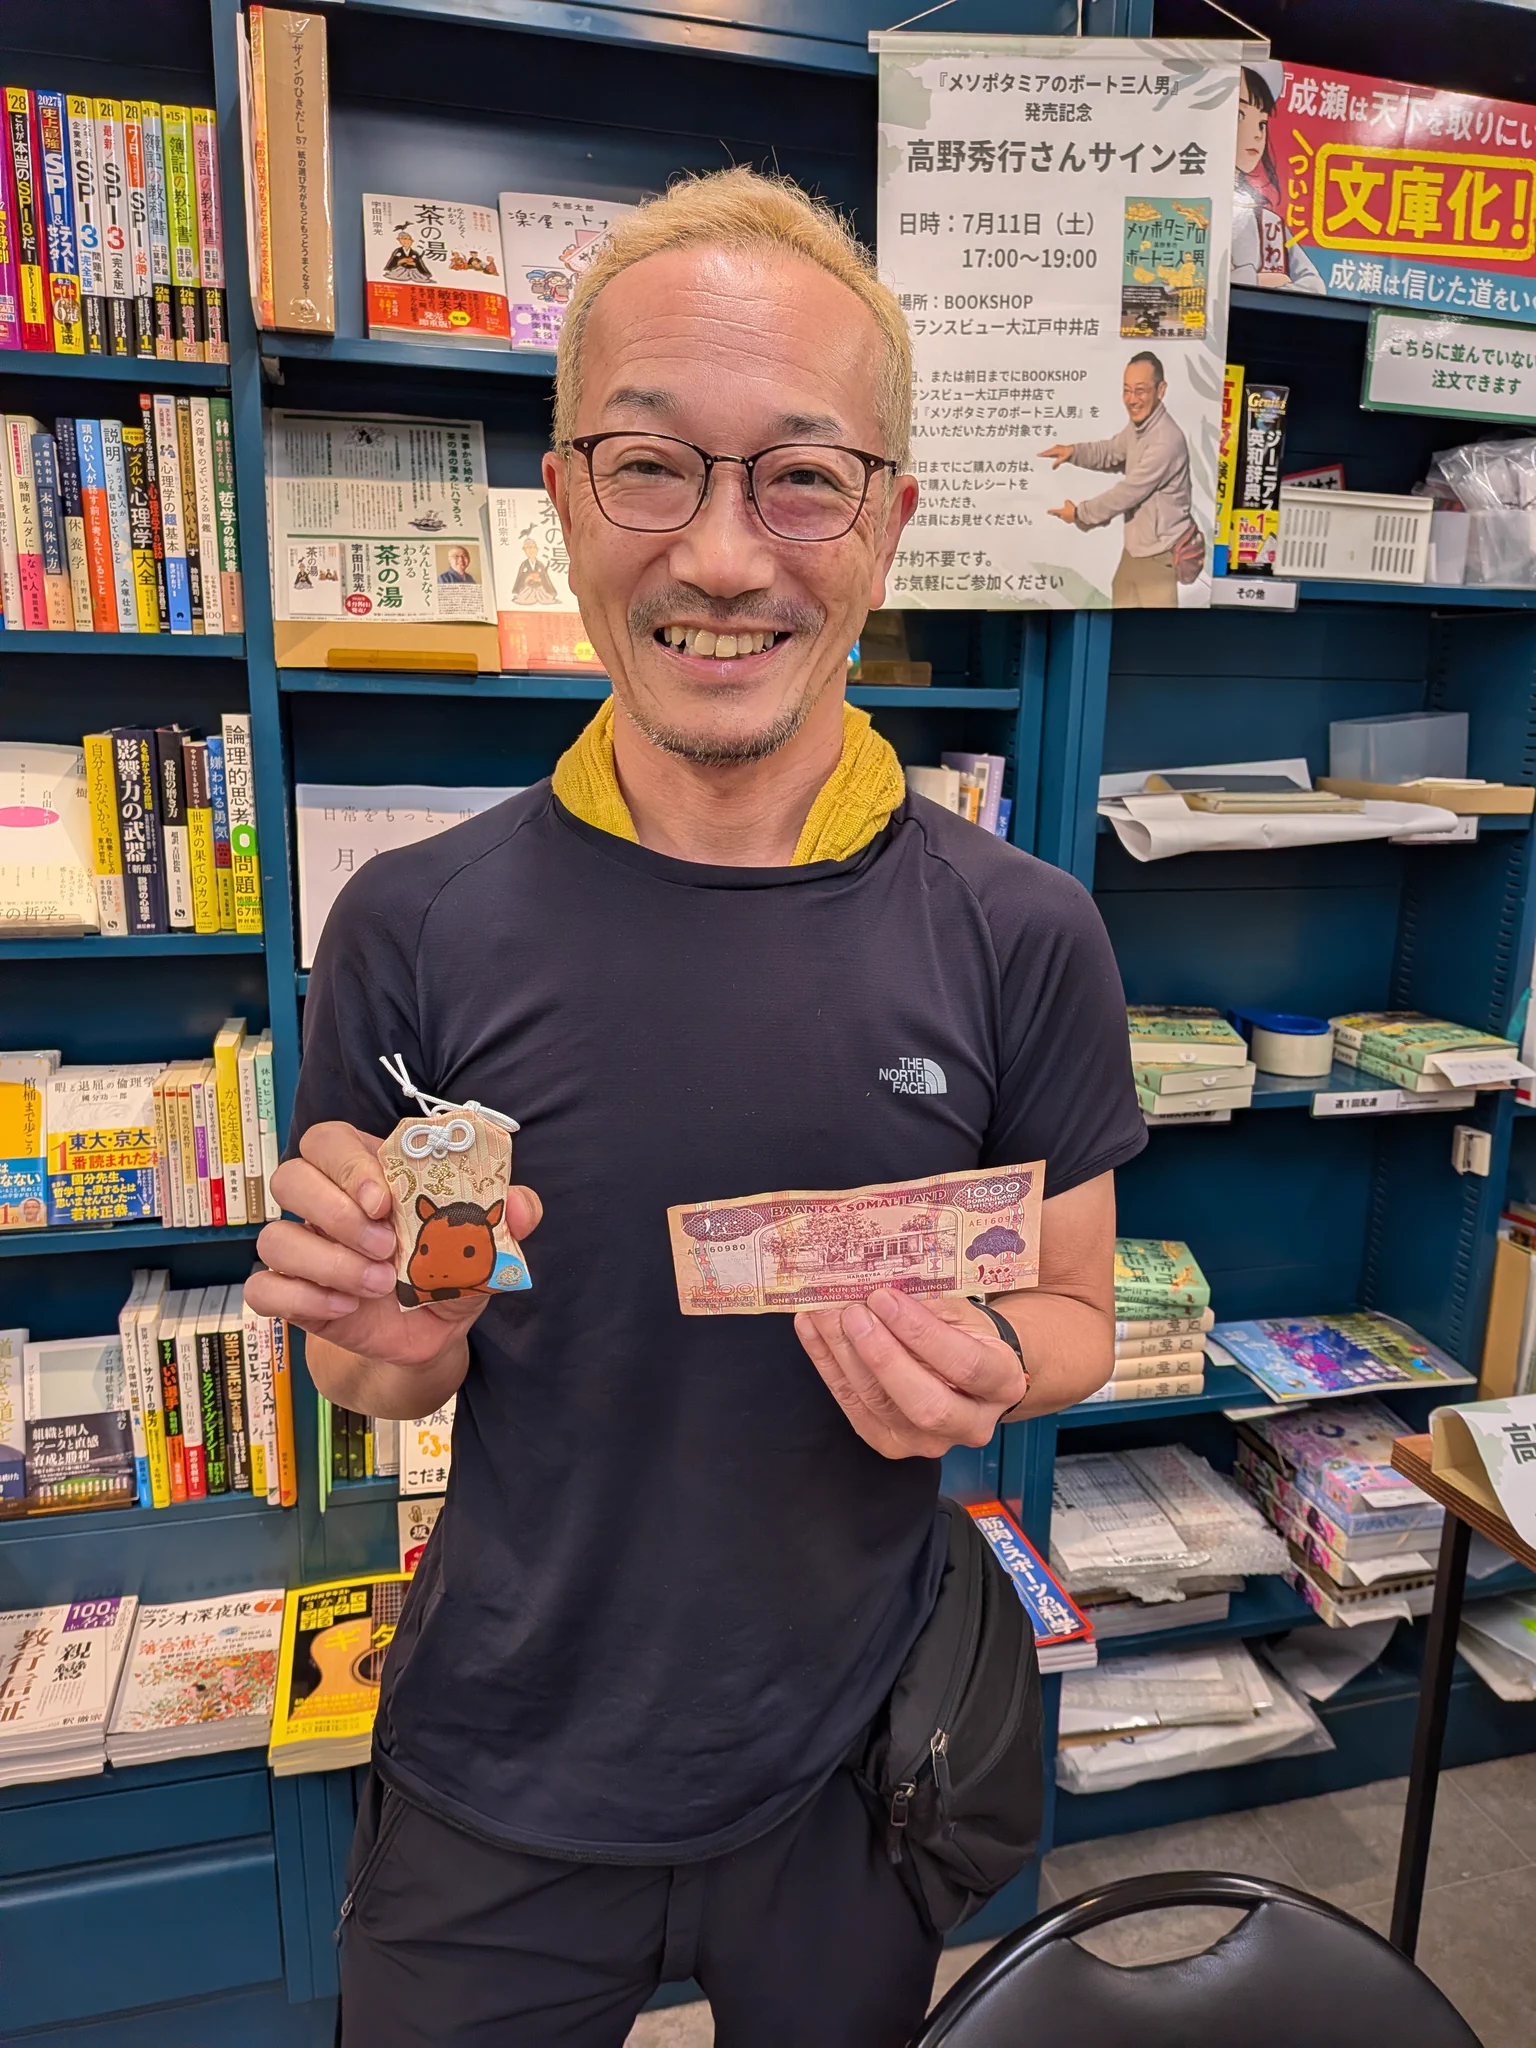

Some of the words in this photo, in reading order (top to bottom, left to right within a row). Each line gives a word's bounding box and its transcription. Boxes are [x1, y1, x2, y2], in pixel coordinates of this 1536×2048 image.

[292, 32, 305, 134] デザインのひきだし
[938, 73, 1180, 97] 『メソポタミアのボート三人男』
[8, 95, 27, 110] '28
[1024, 102, 1093, 123] 発売記念
[42, 111, 62, 150] 史上最強
[72, 121, 83, 157] 企業突破
[297, 136, 308, 146] 57
[907, 139, 1208, 176] 高野秀行さんサイン会
[15, 113, 38, 263] これが本当のSPI3だ!
[169, 136, 193, 245] 簿記の教科書
[198, 139, 221, 247] 簿記の教科書
[552, 201, 595, 212] 矢部太郎
[1286, 154, 1310, 227] ついに
[1326, 160, 1528, 242] 文庫化!
[130, 191, 146, 248] SPI
[371, 200, 384, 237] 宇田川宗光
[413, 203, 448, 263] 茶の湯
[48, 225, 60, 273] センター
[60, 225, 75, 272] テスト
[92, 252, 103, 284] 問題集
[913, 318, 1099, 337] ランスビュー大江戸中井店
[1431, 369, 1522, 395] 注文できます
[194, 408, 212, 533] 心の深層をのぞいてみる図鑑
[1243, 429, 1266, 502] 英和辞典
[81, 423, 106, 595] 頭のいい人が話す前に考えていること
[160, 462, 179, 553] 心理学の超基本
[496, 499, 510, 546] 宇田川宗光
[18, 481, 38, 592] 時間をムダにしない人
[39, 491, 59, 570] 本当の休み方
[68, 518, 85, 570] 休養学
[218, 490, 238, 573] 哲学の教科書
[305, 546, 318, 577] 茶の湯
[351, 544, 365, 592] 宇田川宗光
[373, 544, 404, 608] 茶の湯
[403, 544, 417, 579] わかる
[419, 544, 433, 607] なんとなく
[895, 552, 993, 568] 予約不要です。
[894, 575, 1065, 592] お気軽にご参加ください
[1236, 588, 1265, 601] その他
[92, 743, 112, 836] 自分とか、ないから。
[225, 725, 250, 826] 論理的思考
[117, 738, 147, 863] 影響力の武器
[210, 755, 229, 840] 嫌われる勇気
[191, 811, 211, 919] 世界の果てのカフェ
[234, 855, 255, 895] 問題
[0, 905, 65, 922] の哲学。
[136, 876, 150, 923] 説得の心理学
[878, 1067, 925, 1083] NORTH
[898, 1057, 924, 1070] THE
[54, 1077, 155, 1093] 暇と退屈の倫理学
[892, 1081, 926, 1095] FACE
[23, 1077, 36, 1155] 棺桶まで歩こう
[225, 1088, 242, 1164] がんと生ききる
[53, 1184, 136, 1198] 哲学書で涙するとは
[771, 1205, 841, 1218] BAANKA
[846, 1190, 947, 1213] SOMALILAND
[966, 1182, 1020, 1199] 1000
[966, 1193, 1019, 1205] SOMALILAND
[71, 1203, 128, 1222] 若林正恭
[690, 1283, 754, 1296] 1000
[771, 1297, 790, 1305] ONE
[792, 1294, 845, 1303] THOUSAND
[828, 1285, 850, 1294] KUN
[261, 1358, 275, 1415] ゴルフ入門
[33, 1424, 89, 1441] 組織と個人
[33, 1436, 99, 1453] データと直感
[33, 1449, 90, 1468] 育成と勝利
[140, 1603, 252, 1630] ラジオ深夜便
